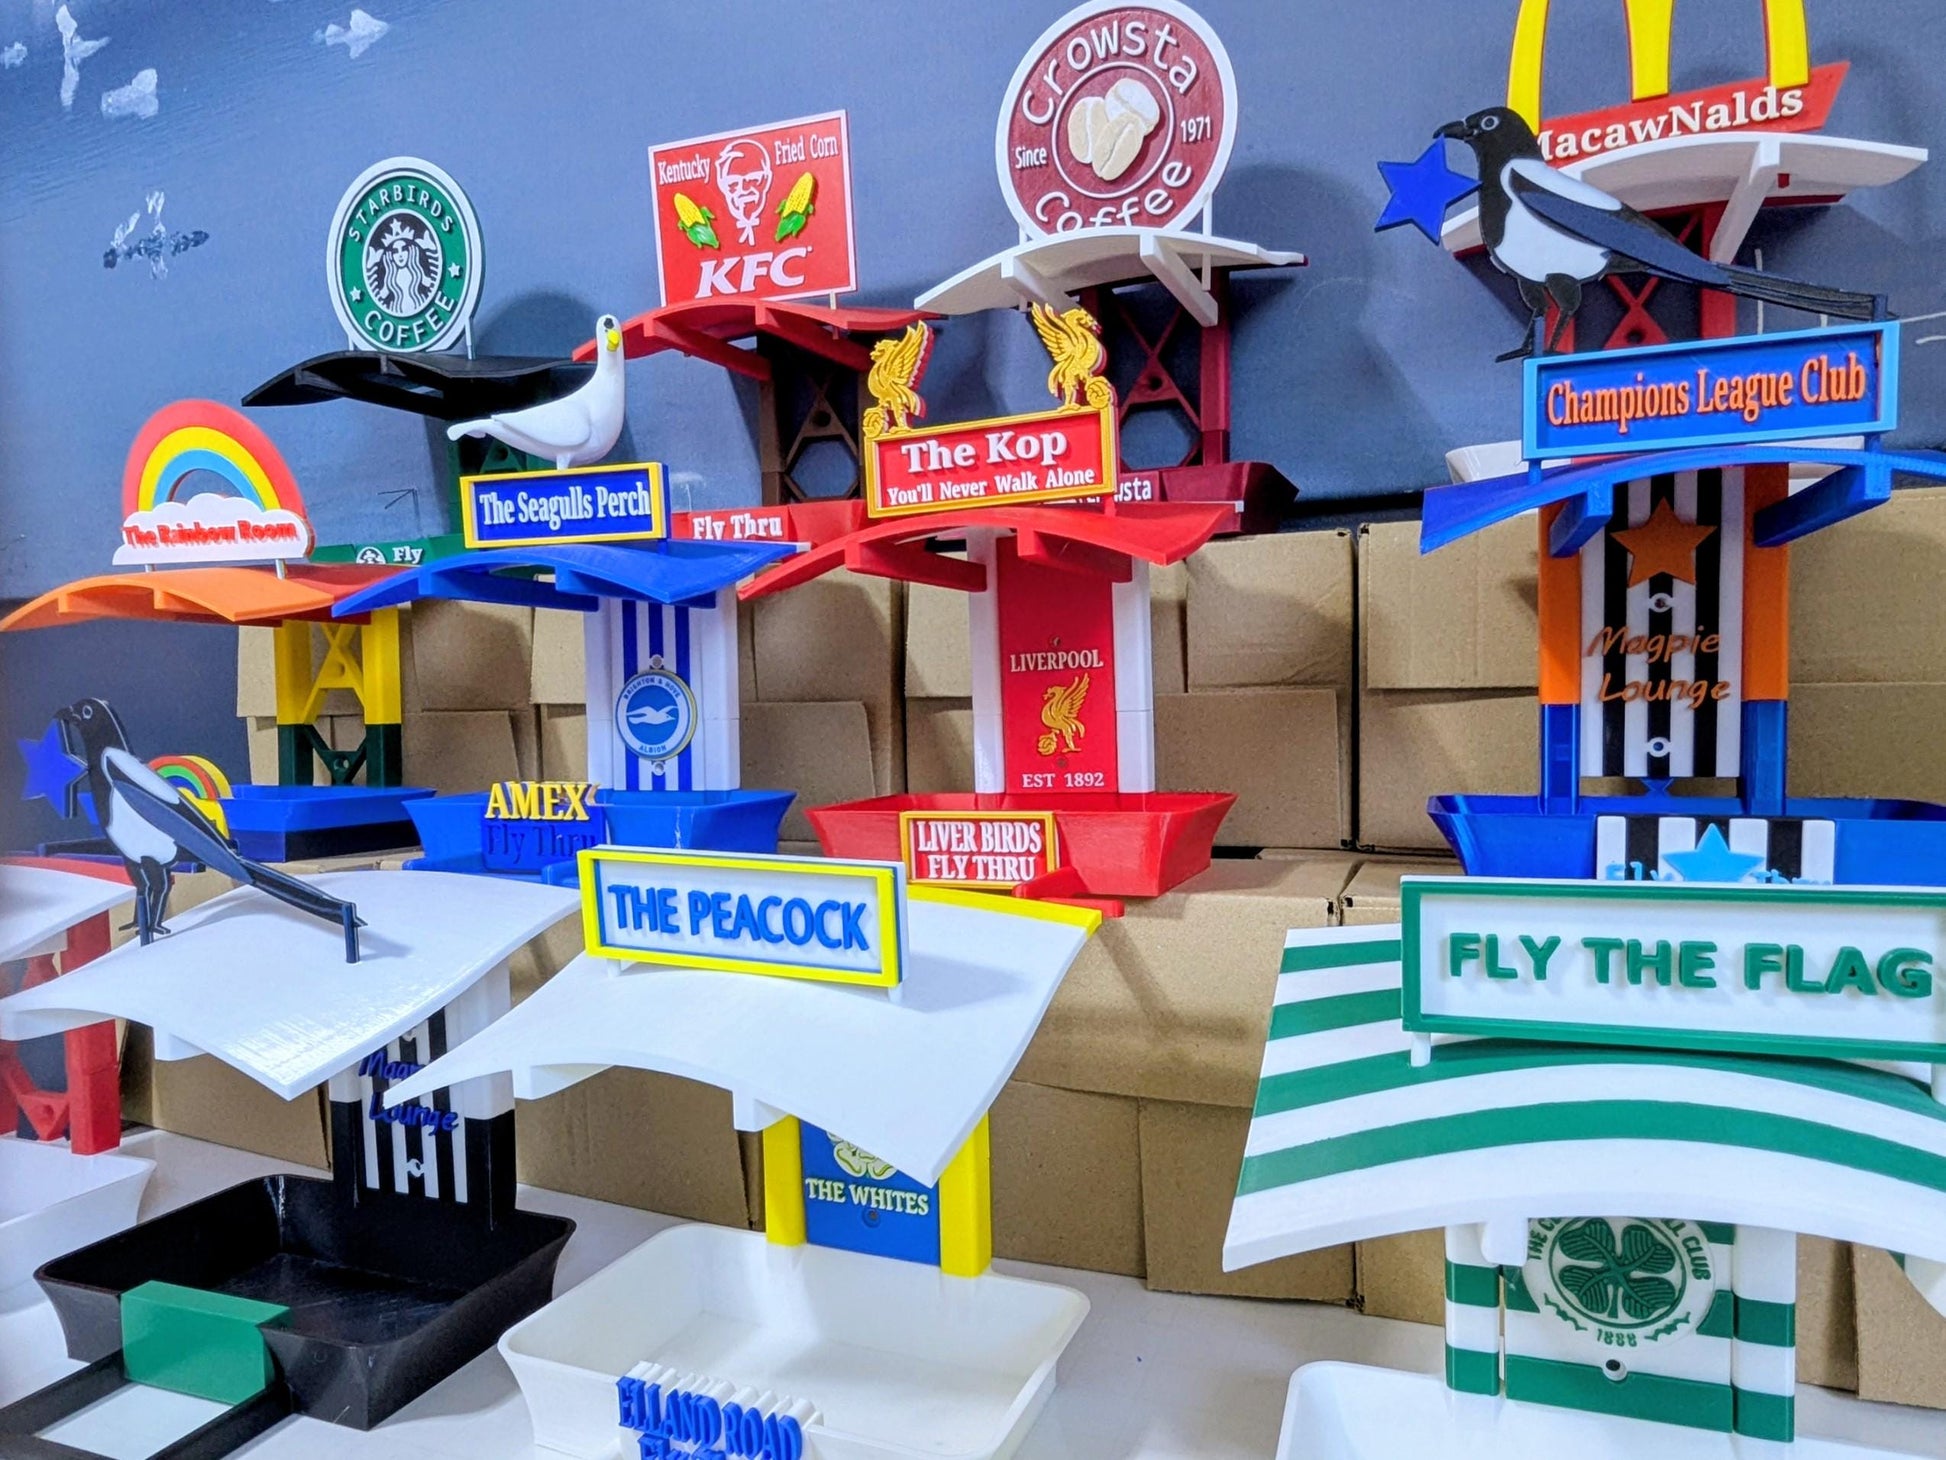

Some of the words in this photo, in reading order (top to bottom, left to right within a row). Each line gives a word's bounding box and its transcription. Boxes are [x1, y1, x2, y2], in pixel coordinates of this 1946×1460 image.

[1022, 20, 1198, 125] Crowsta
[1181, 116, 1212, 143] 1971
[657, 153, 711, 185] Kentucky
[774, 136, 806, 166] Fried
[810, 134, 839, 159] Corn
[1015, 147, 1048, 169] Since
[349, 184, 454, 242] STARBIRDS
[695, 247, 806, 299] KFC
[364, 291, 455, 346] COFFEE
[1548, 372, 1690, 434] Champions
[1697, 368, 1794, 422] League
[1801, 352, 1867, 404] Club
[901, 438, 976, 473] The
[985, 430, 1067, 467] Kop
[480, 490, 511, 525] The
[517, 486, 593, 531] Seagulls
[595, 481, 652, 519] Perch
[887, 483, 933, 507] You'll
[939, 479, 987, 502] Never
[994, 470, 1038, 494] Walk
[1045, 467, 1096, 489] Alone
[123, 525, 158, 546] The
[237, 520, 298, 541] Room
[692, 515, 726, 541] Fly
[730, 512, 783, 539] Thru
[392, 545, 423, 564] Fly
[1010, 649, 1104, 672] LIVERPOOL
[1587, 625, 1721, 664] Magpie
[1598, 672, 1731, 710] Lounge
[639, 744, 667, 754] ALBION
[1022, 773, 1055, 788] EST
[1064, 772, 1105, 787] 1892
[484, 781, 592, 820] AMEX
[487, 824, 525, 864] Fly
[916, 821, 977, 852] LIVER
[980, 821, 1042, 853] BIRDS
[927, 855, 971, 879] FLY
[972, 855, 1035, 880] THRU
[608, 884, 680, 934] THE
[688, 890, 870, 951] PEACOCK
[1449, 932, 1561, 981] FLY
[1581, 937, 1717, 988] THE
[1744, 943, 1933, 998] FLAG
[369, 1092, 459, 1136] Lounge
[806, 1178, 846, 1203] THE
[849, 1184, 929, 1216] WHITES
[1682, 1236, 1711, 1281] CLUB
[721, 1402, 803, 1460] ROAD
